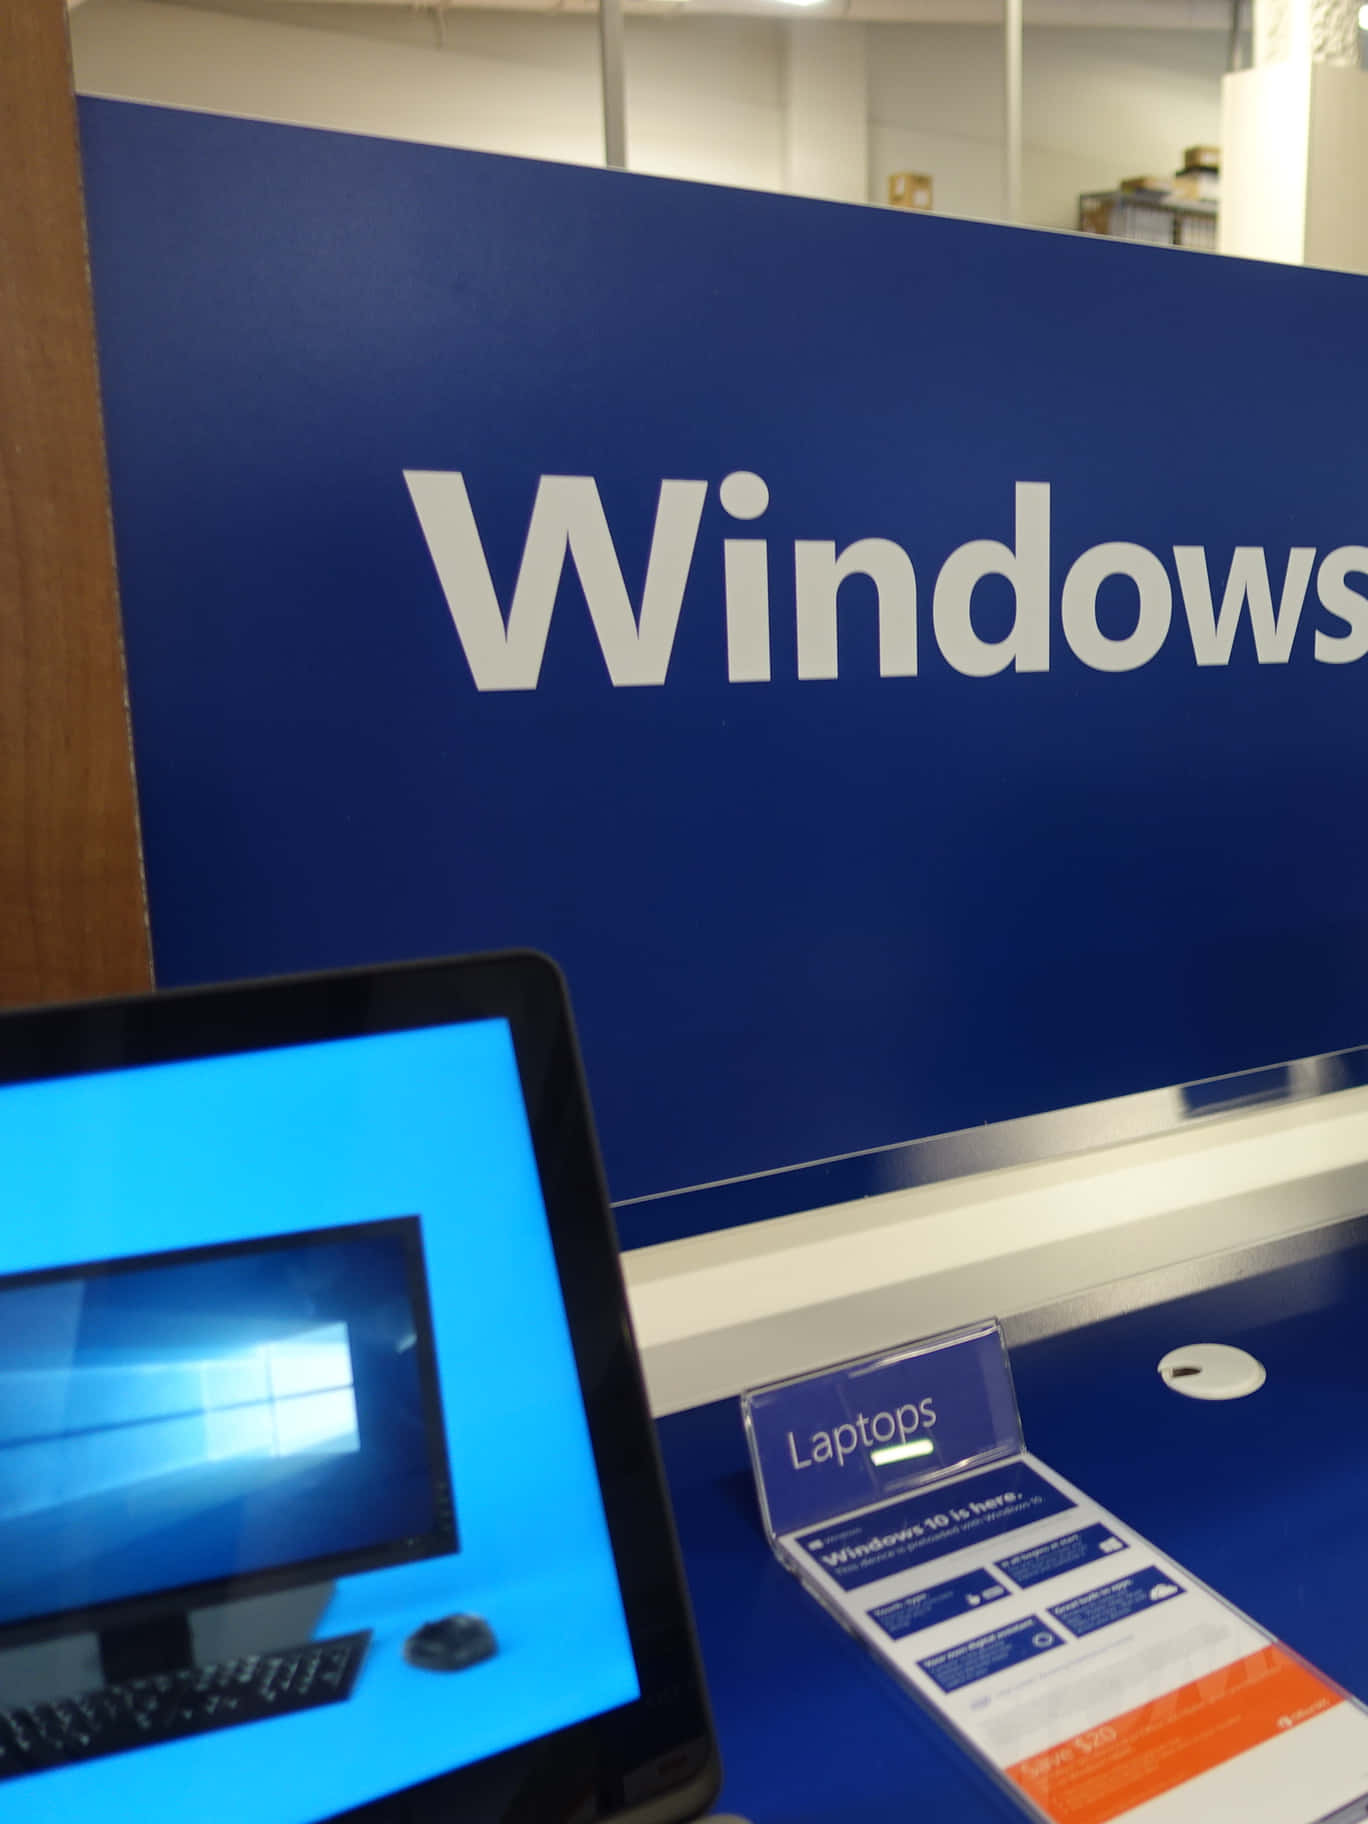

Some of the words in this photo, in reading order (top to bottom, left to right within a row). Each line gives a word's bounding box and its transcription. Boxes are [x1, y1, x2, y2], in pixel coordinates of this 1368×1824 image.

[786, 1397, 937, 1471] Laptops
[822, 1523, 925, 1567] Windows
[923, 1513, 949, 1532] 10
[950, 1502, 971, 1523] is
[969, 1491, 1023, 1515] here.
